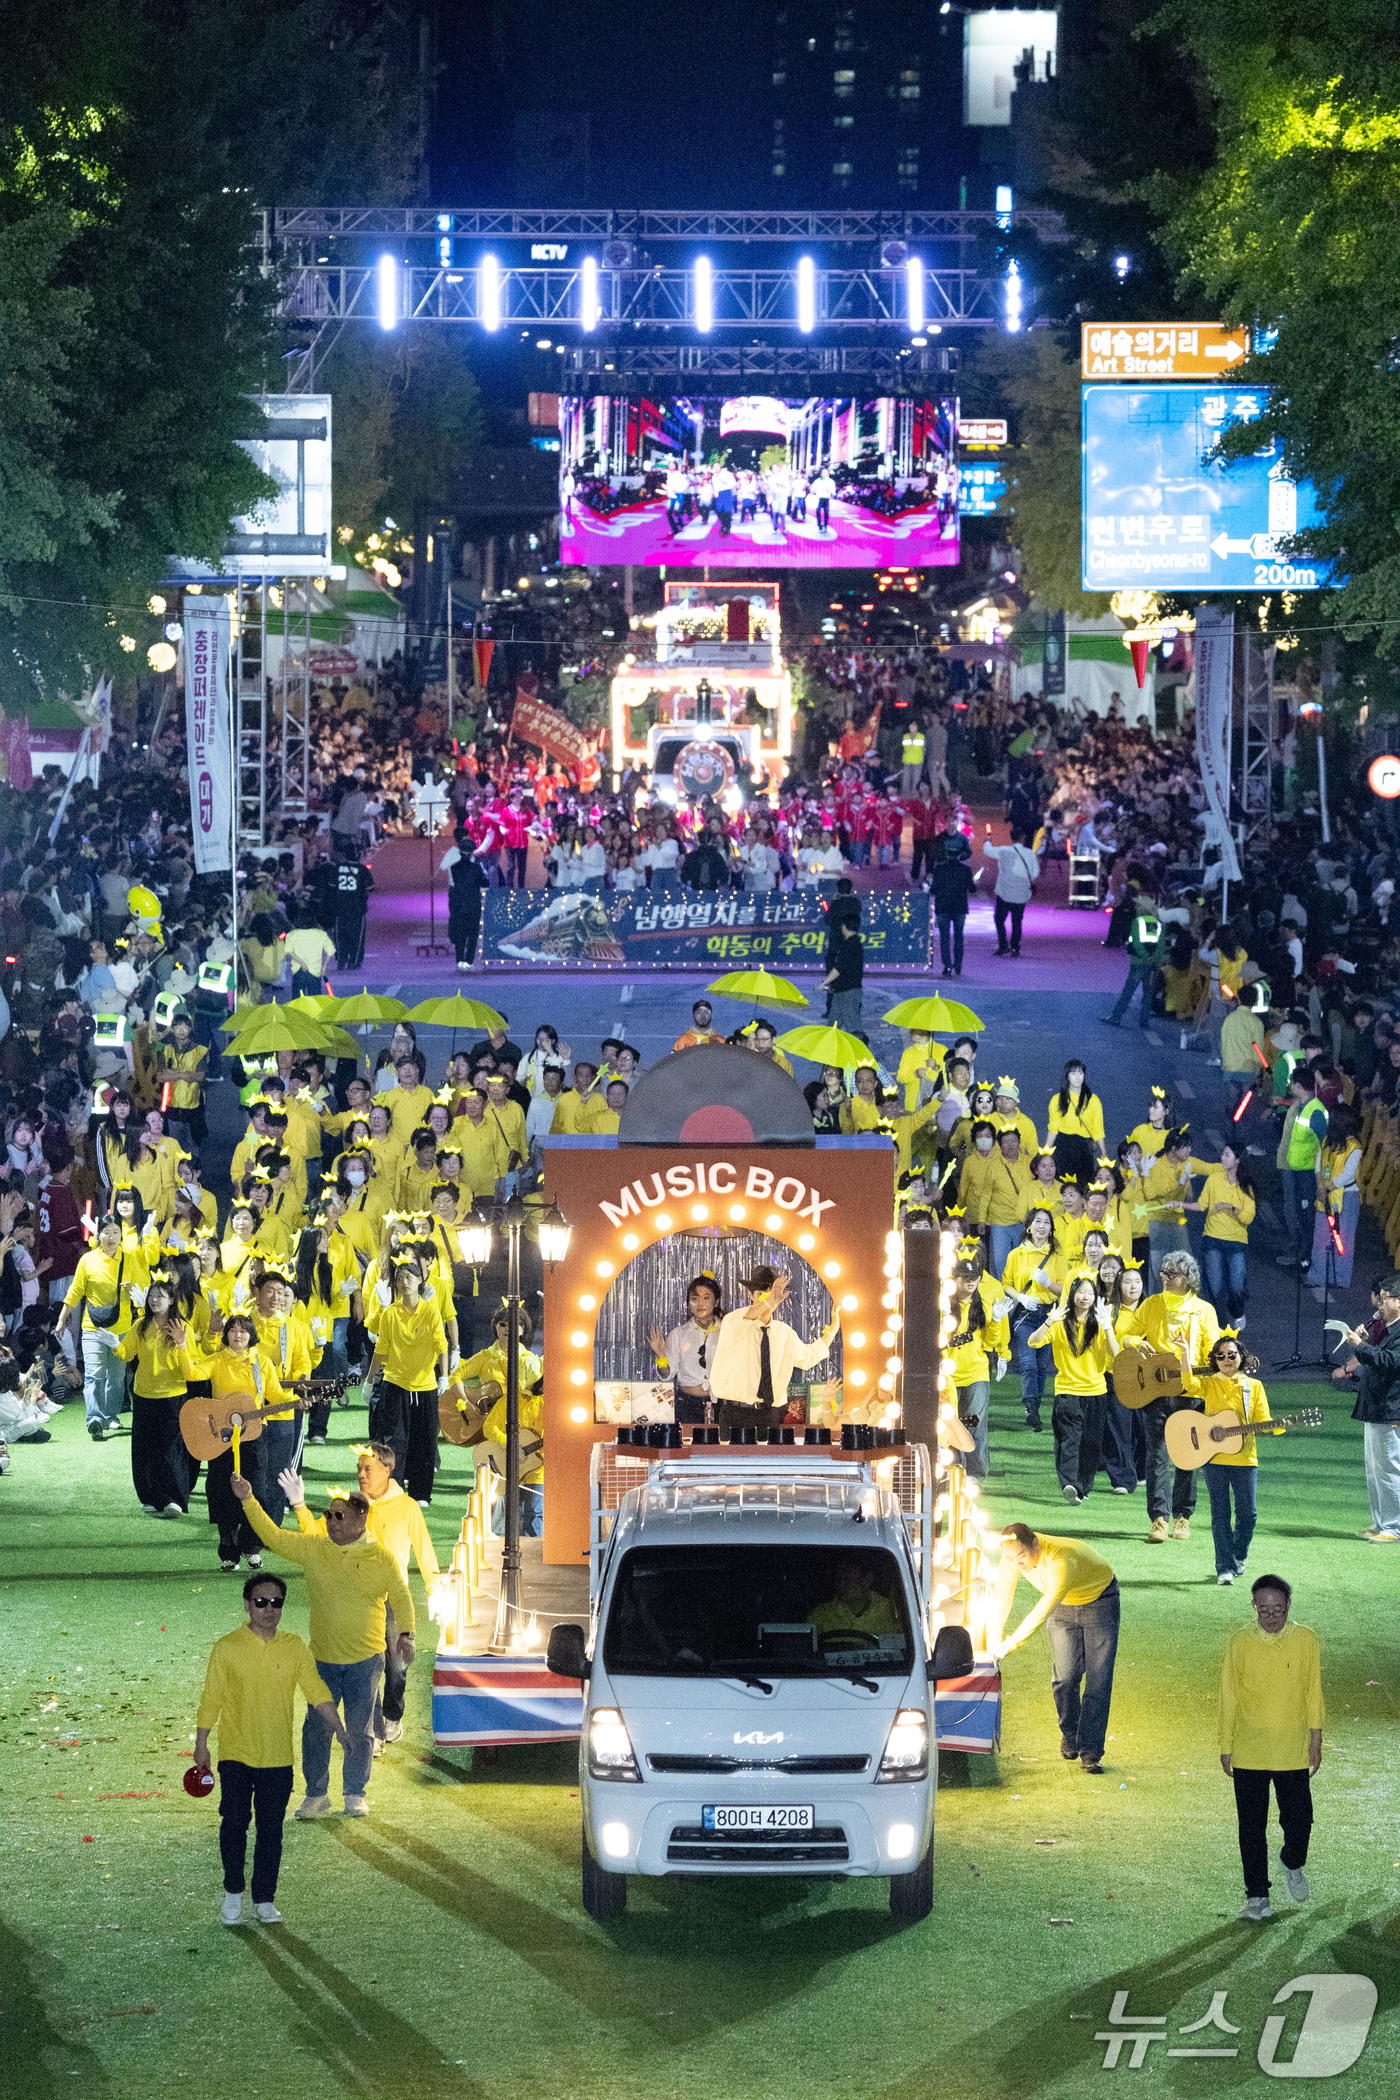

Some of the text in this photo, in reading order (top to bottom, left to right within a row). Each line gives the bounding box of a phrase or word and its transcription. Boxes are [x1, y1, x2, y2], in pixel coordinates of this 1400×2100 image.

[1090, 329, 1199, 356] 예술의거리
[1091, 356, 1174, 373] Art Street
[1254, 564, 1316, 585] 200m
[193, 629, 208, 766] 충장퍼레이드
[338, 875, 358, 891] 23
[634, 901, 757, 931] 남행열차를
[706, 930, 886, 958] 학동의 추억로
[598, 1162, 837, 1228] MUSIC BOX
[733, 1731, 784, 1744] KIA
[717, 1809, 809, 1826] 800더 4208
